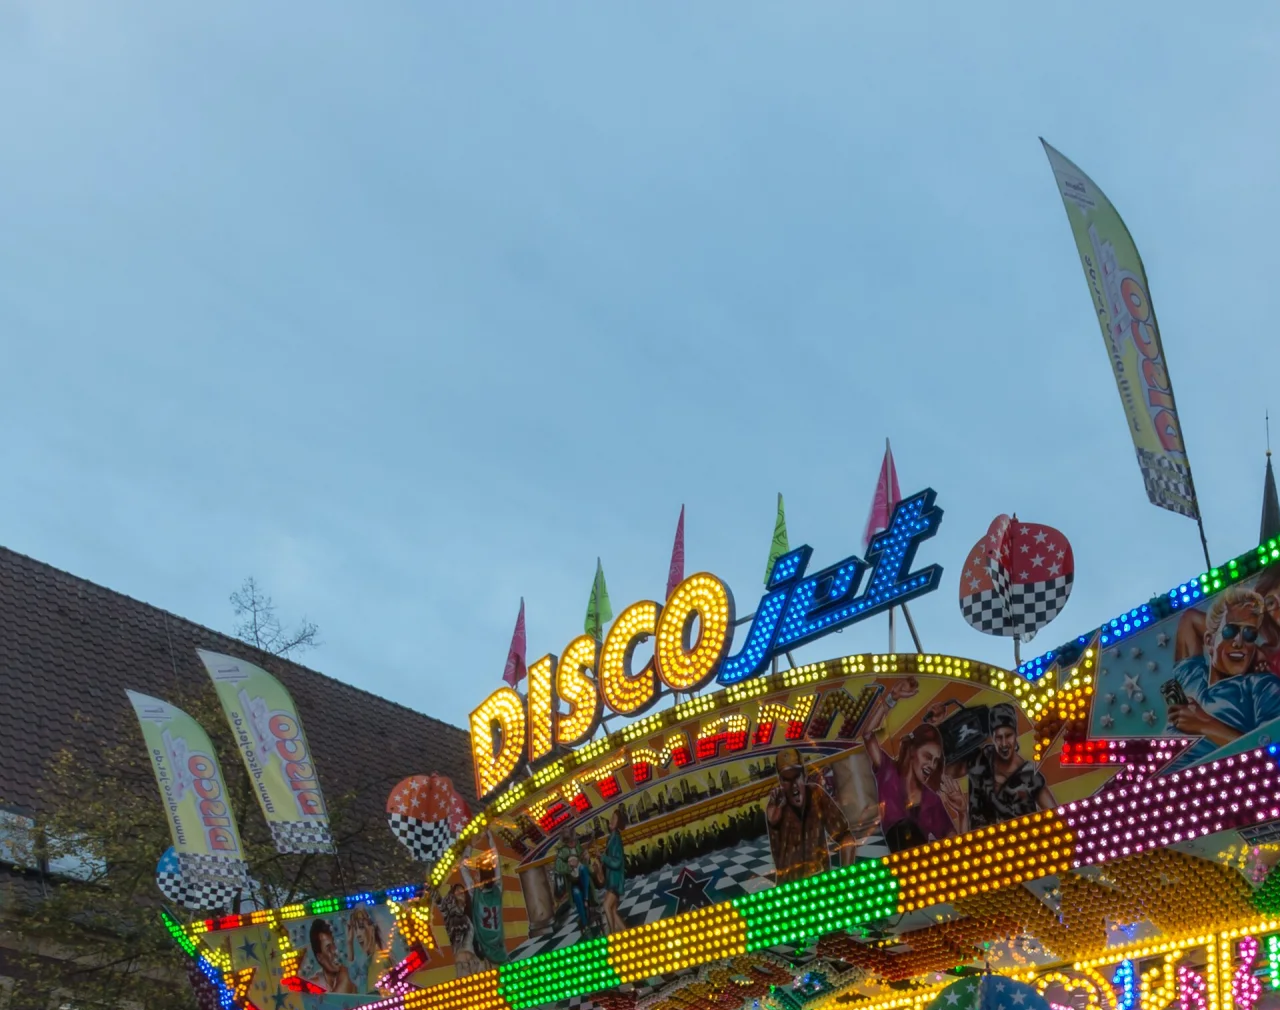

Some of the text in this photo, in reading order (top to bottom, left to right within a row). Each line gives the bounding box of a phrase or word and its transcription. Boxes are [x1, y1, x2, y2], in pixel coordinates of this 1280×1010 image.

[469, 487, 944, 800] DISCO jet
[498, 683, 884, 858] HEITMANN
[481, 904, 499, 930] 21
